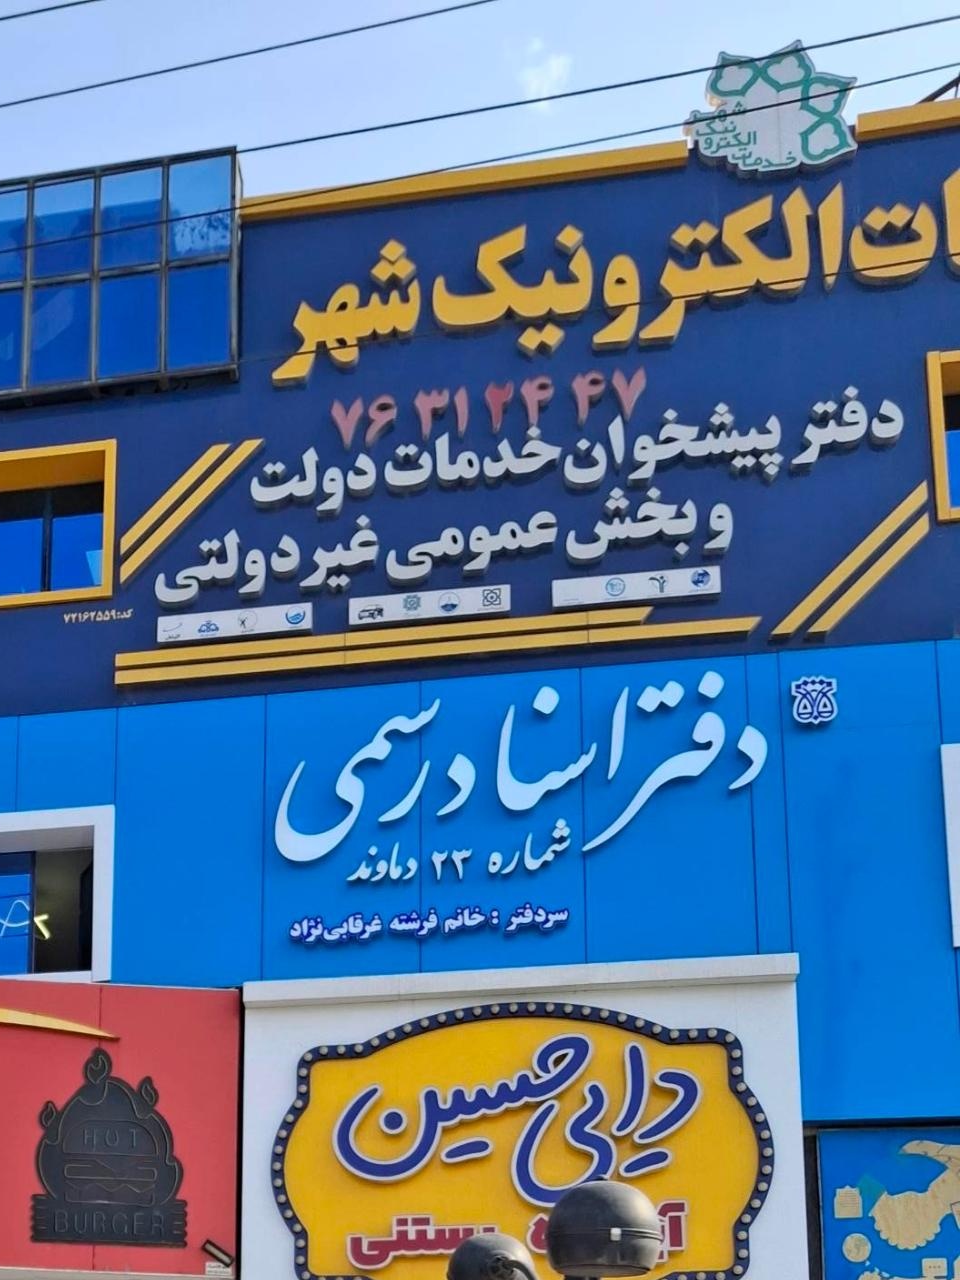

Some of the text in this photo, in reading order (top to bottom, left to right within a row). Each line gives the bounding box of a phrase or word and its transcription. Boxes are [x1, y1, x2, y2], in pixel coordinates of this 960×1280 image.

[272, 238, 421, 383] شهر
[250, 385, 904, 513] دفتر پیشخوان خدمات دولت
[385, 511, 558, 580] عمومی
[566, 487, 697, 560] بخش
[703, 503, 733, 549] و
[275, 671, 768, 862] دفتر اسناد رسمی
[346, 818, 572, 882] شماره ۲۳ دماوند
[389, 908, 438, 936] فرشته
[444, 906, 486, 934] خانم
[334, 1034, 591, 1181] حسین
[54, 1208, 165, 1236] BURGER
